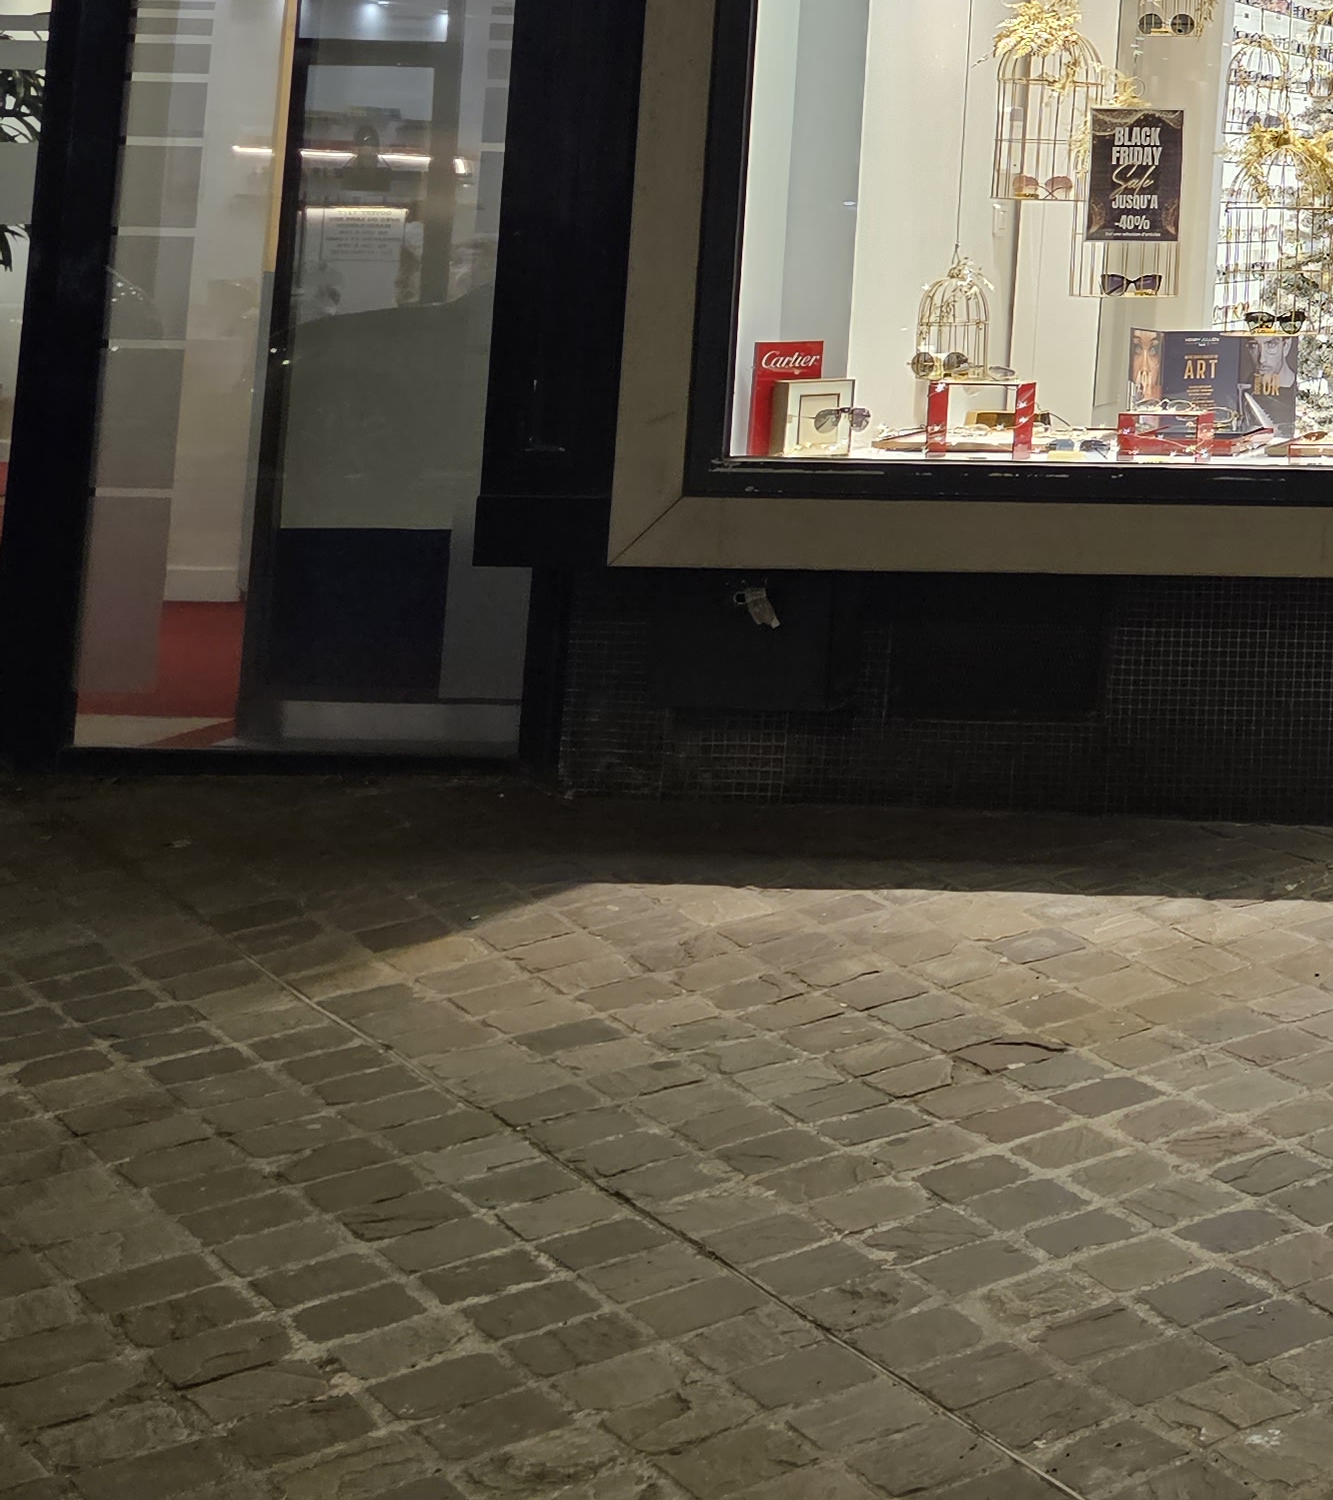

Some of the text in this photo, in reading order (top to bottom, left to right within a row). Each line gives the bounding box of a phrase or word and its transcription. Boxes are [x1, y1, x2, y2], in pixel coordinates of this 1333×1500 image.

[1114, 127, 1161, 146] BLACK
[1111, 147, 1163, 165] FRIDAY
[1109, 163, 1156, 199] Sale
[1111, 194, 1158, 209] JUSQU'A
[1114, 215, 1150, 230] -40%
[762, 351, 820, 372] Cartier
[1184, 359, 1218, 379] ART
